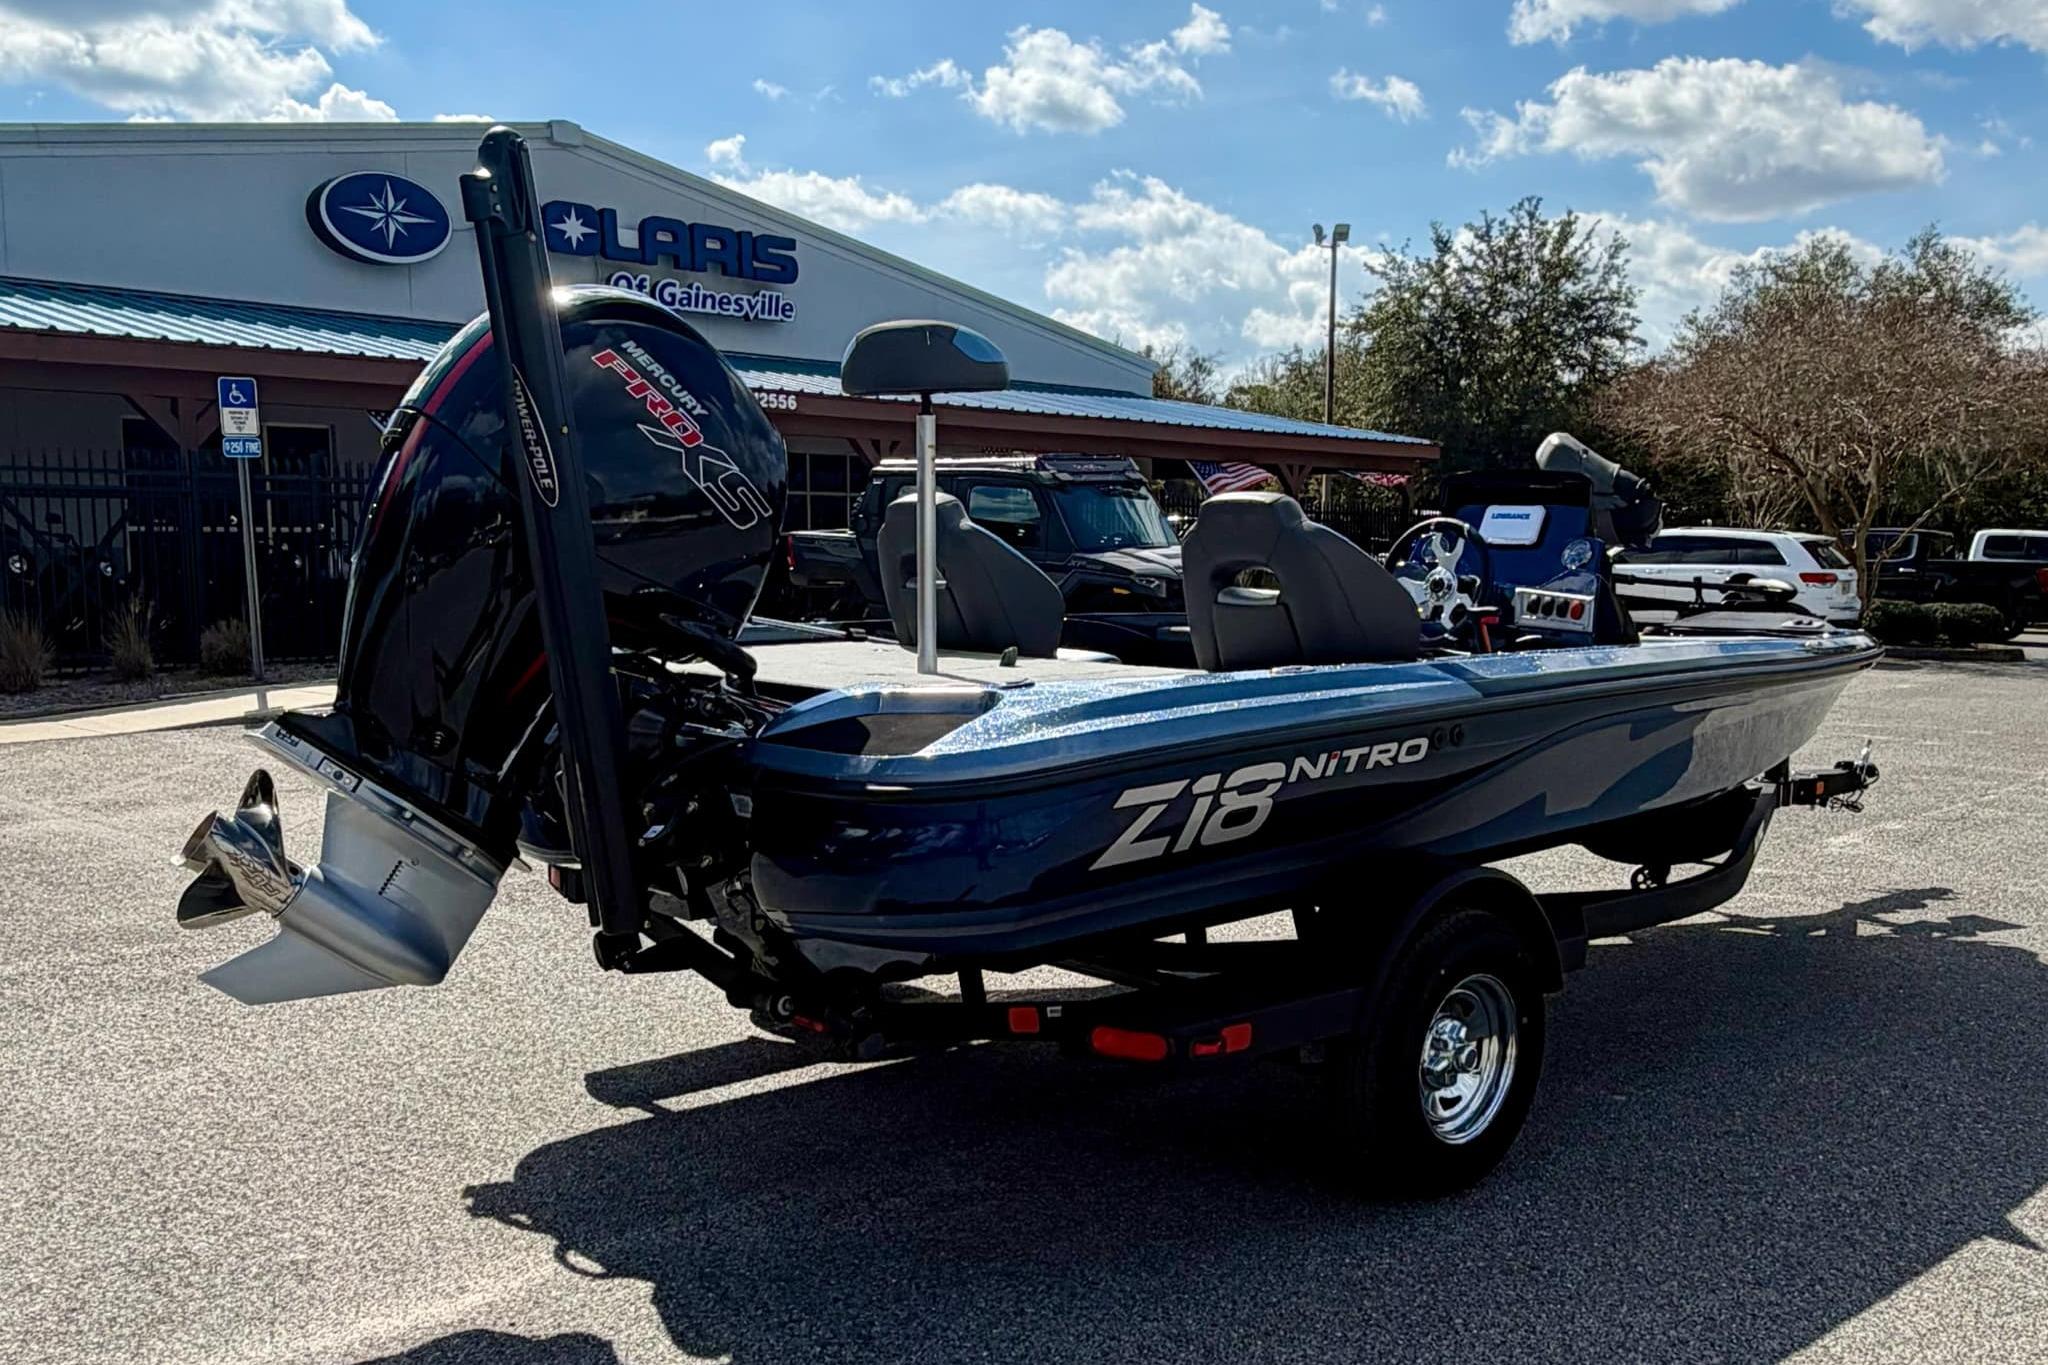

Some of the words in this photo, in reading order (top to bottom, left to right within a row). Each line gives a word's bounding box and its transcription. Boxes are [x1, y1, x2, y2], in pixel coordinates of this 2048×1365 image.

[541, 200, 799, 285] OLARIS
[654, 278, 796, 322] Gainesville
[591, 348, 704, 449] PRO
[620, 339, 710, 417] MERCURY
[636, 407, 773, 530] XS
[1088, 761, 1287, 872] Z18
[1287, 737, 1430, 784] NITRO
